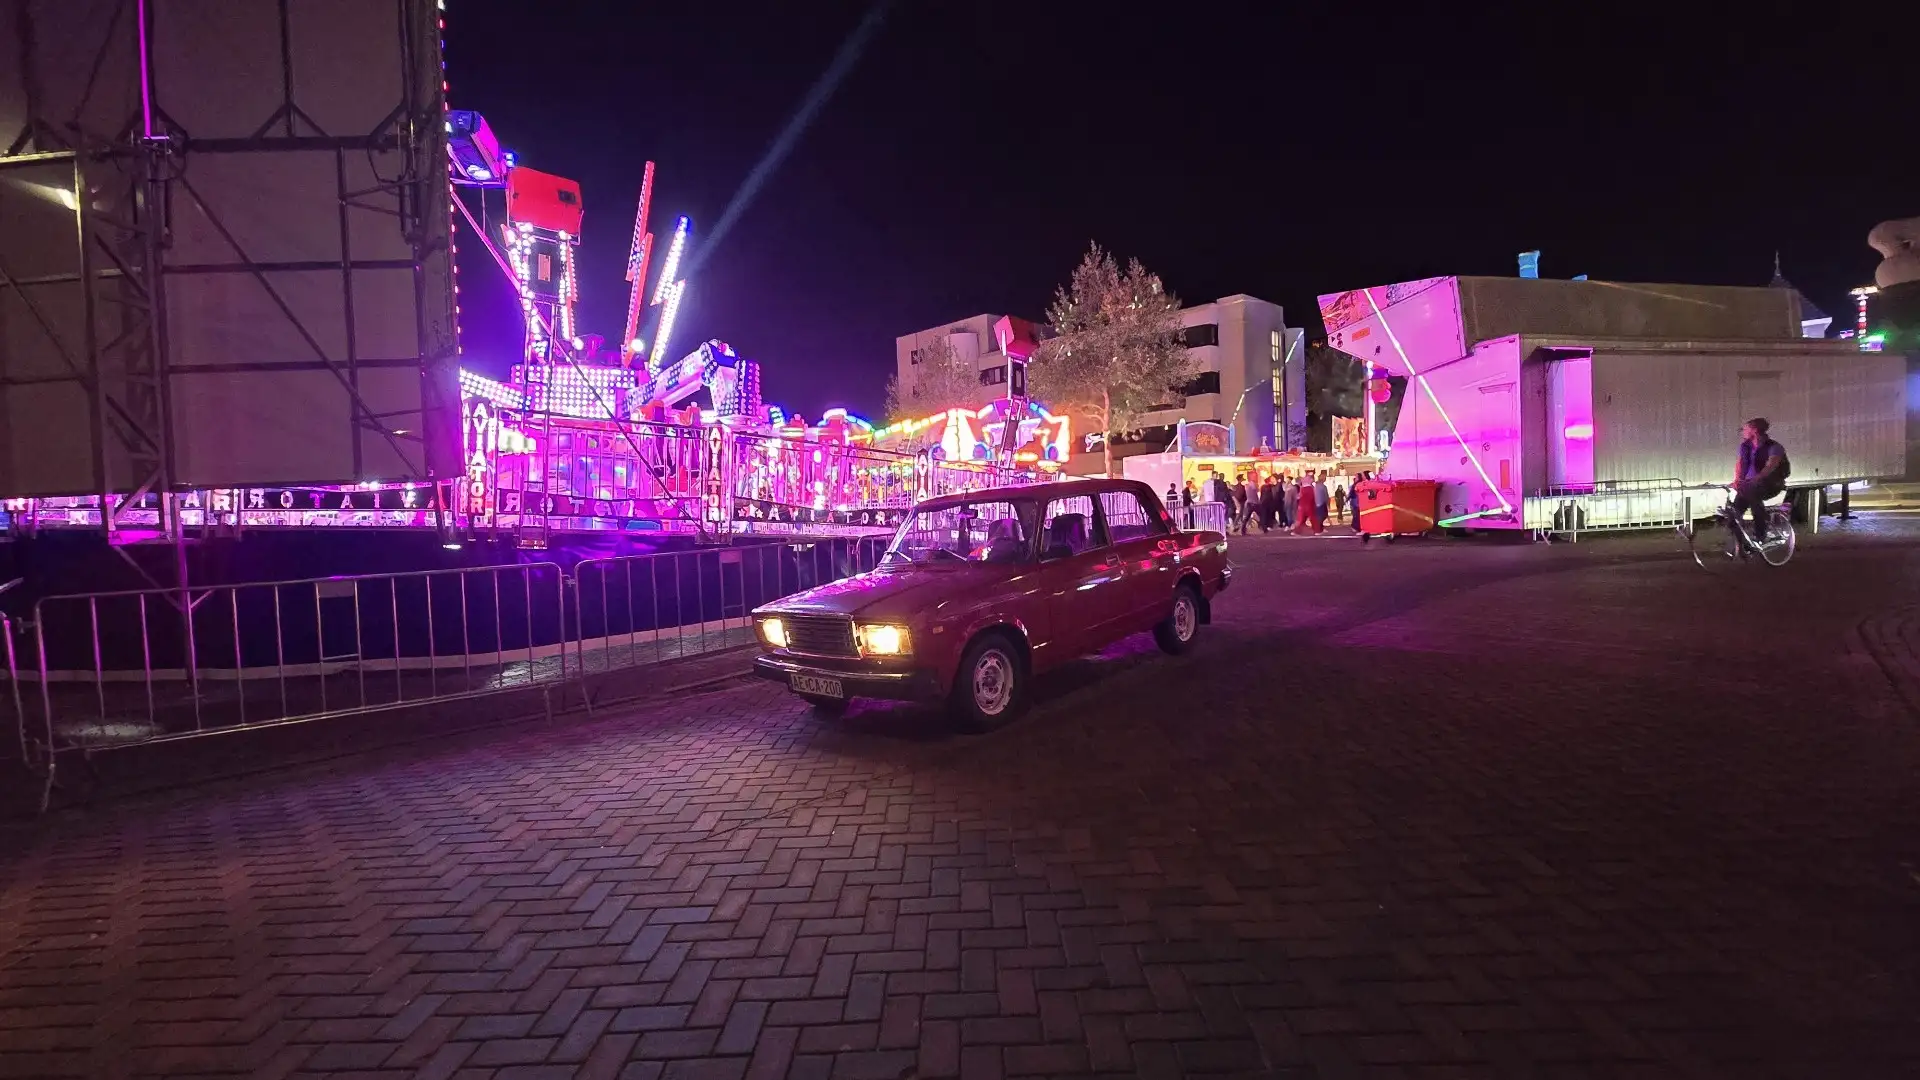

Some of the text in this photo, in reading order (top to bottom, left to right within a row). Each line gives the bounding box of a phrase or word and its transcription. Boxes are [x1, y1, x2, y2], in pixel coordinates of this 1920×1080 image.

[471, 402, 489, 514] AVIATOR
[708, 427, 721, 521] AVIATOR
[767, 504, 886, 526] AVIATOR
